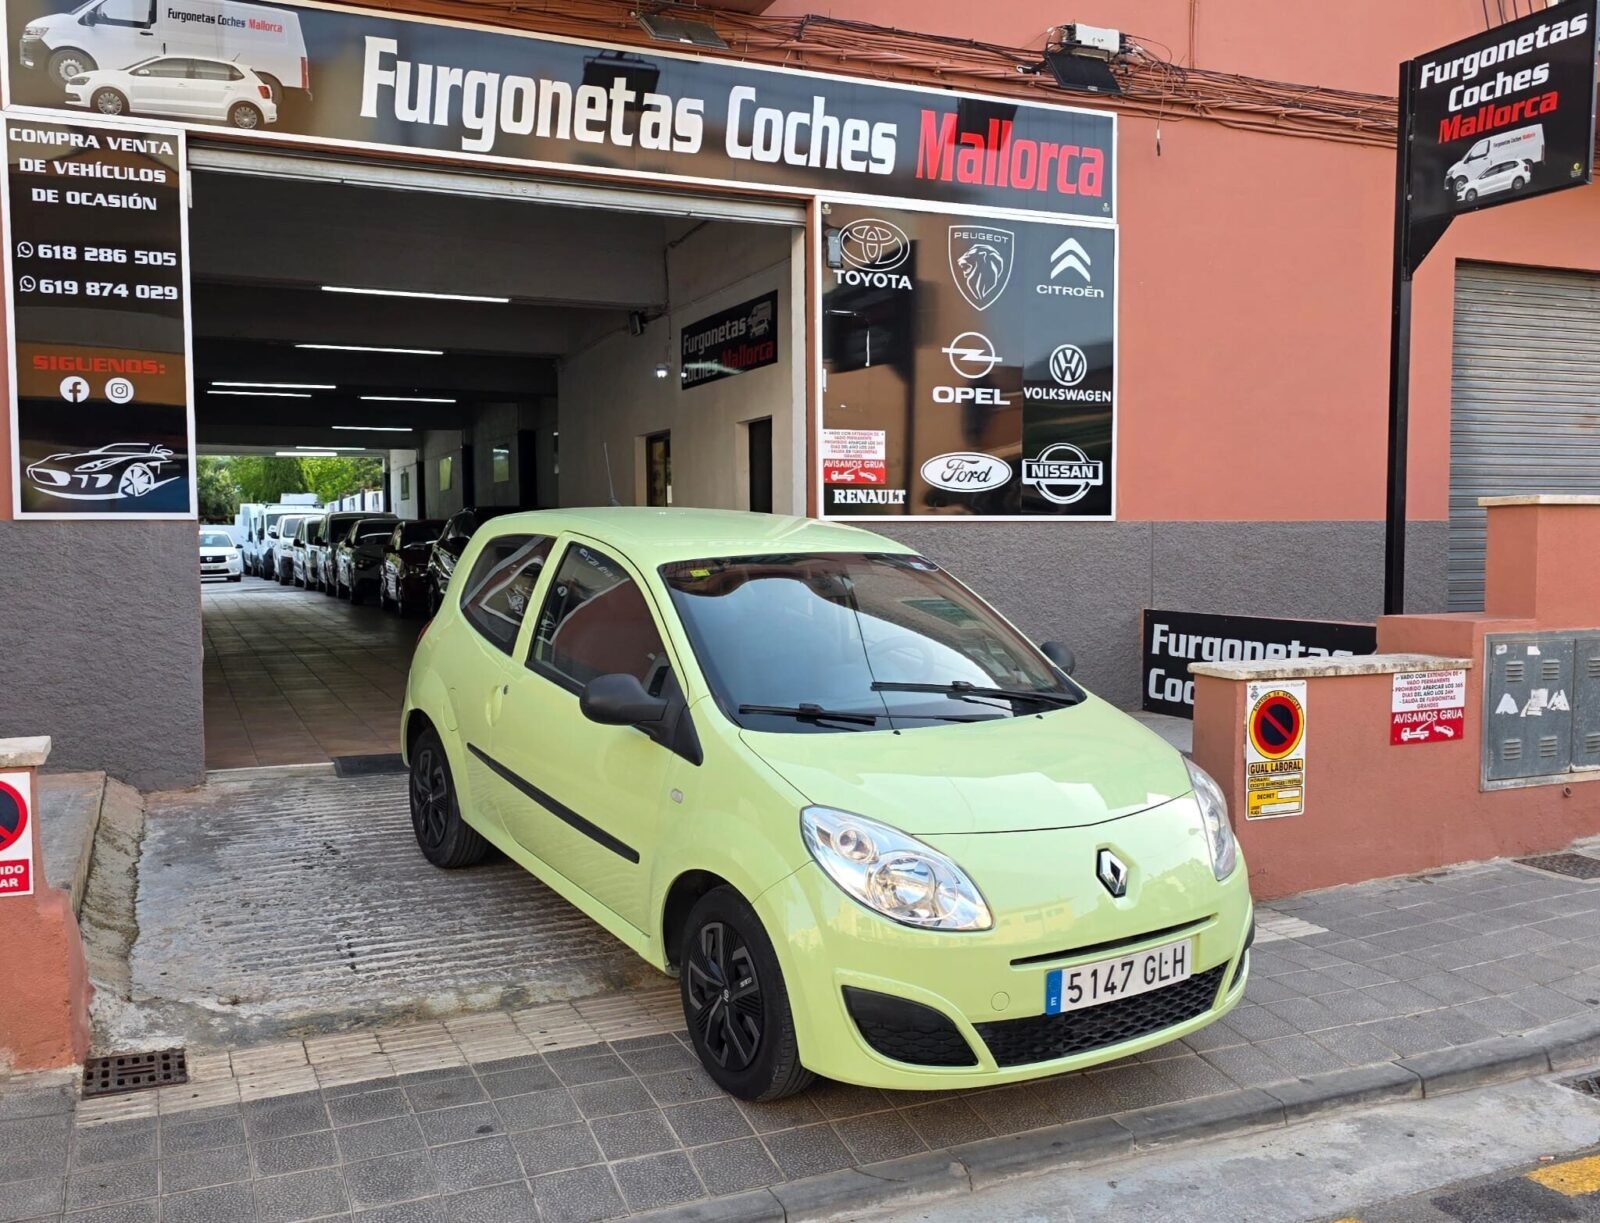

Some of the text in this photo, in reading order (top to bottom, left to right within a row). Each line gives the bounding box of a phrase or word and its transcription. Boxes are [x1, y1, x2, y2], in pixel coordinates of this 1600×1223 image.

[168, 8, 283, 33] Furgonetas Coches Mallorca
[1419, 13, 1588, 90] Furgonetas
[1448, 62, 1550, 112] Coches
[360, 35, 1104, 197] Furgonetas Coches Mallorca
[1437, 91, 1560, 144] Mallorca
[9, 128, 174, 155] COMPRA VENTA
[19, 157, 166, 183] DE VEHÍCULOS
[31, 188, 157, 210] DE OCASIÓN
[954, 231, 1009, 244] PEUGEOT
[38, 244, 177, 266] 618 286 505
[40, 279, 178, 300] 619 874 029
[833, 269, 913, 290] TOYOTA
[683, 317, 746, 355] Furgonetas
[33, 355, 166, 374] SIGUENOS:
[722, 341, 774, 368] Mallorca
[932, 386, 1011, 405] OPEL
[1024, 387, 1111, 402] VOLKSWAGEN
[824, 460, 885, 469] AVISAMOS GRUA
[941, 459, 991, 483] Ford
[1031, 464, 1094, 479] NISSAN
[833, 489, 906, 504] RENAULT
[1394, 709, 1463, 724] AVISAMOS GRUA
[1250, 761, 1301, 774] GUAL LABORAL
[1067, 960, 1134, 1004] 5147
[1050, 996, 1057, 1006] E
